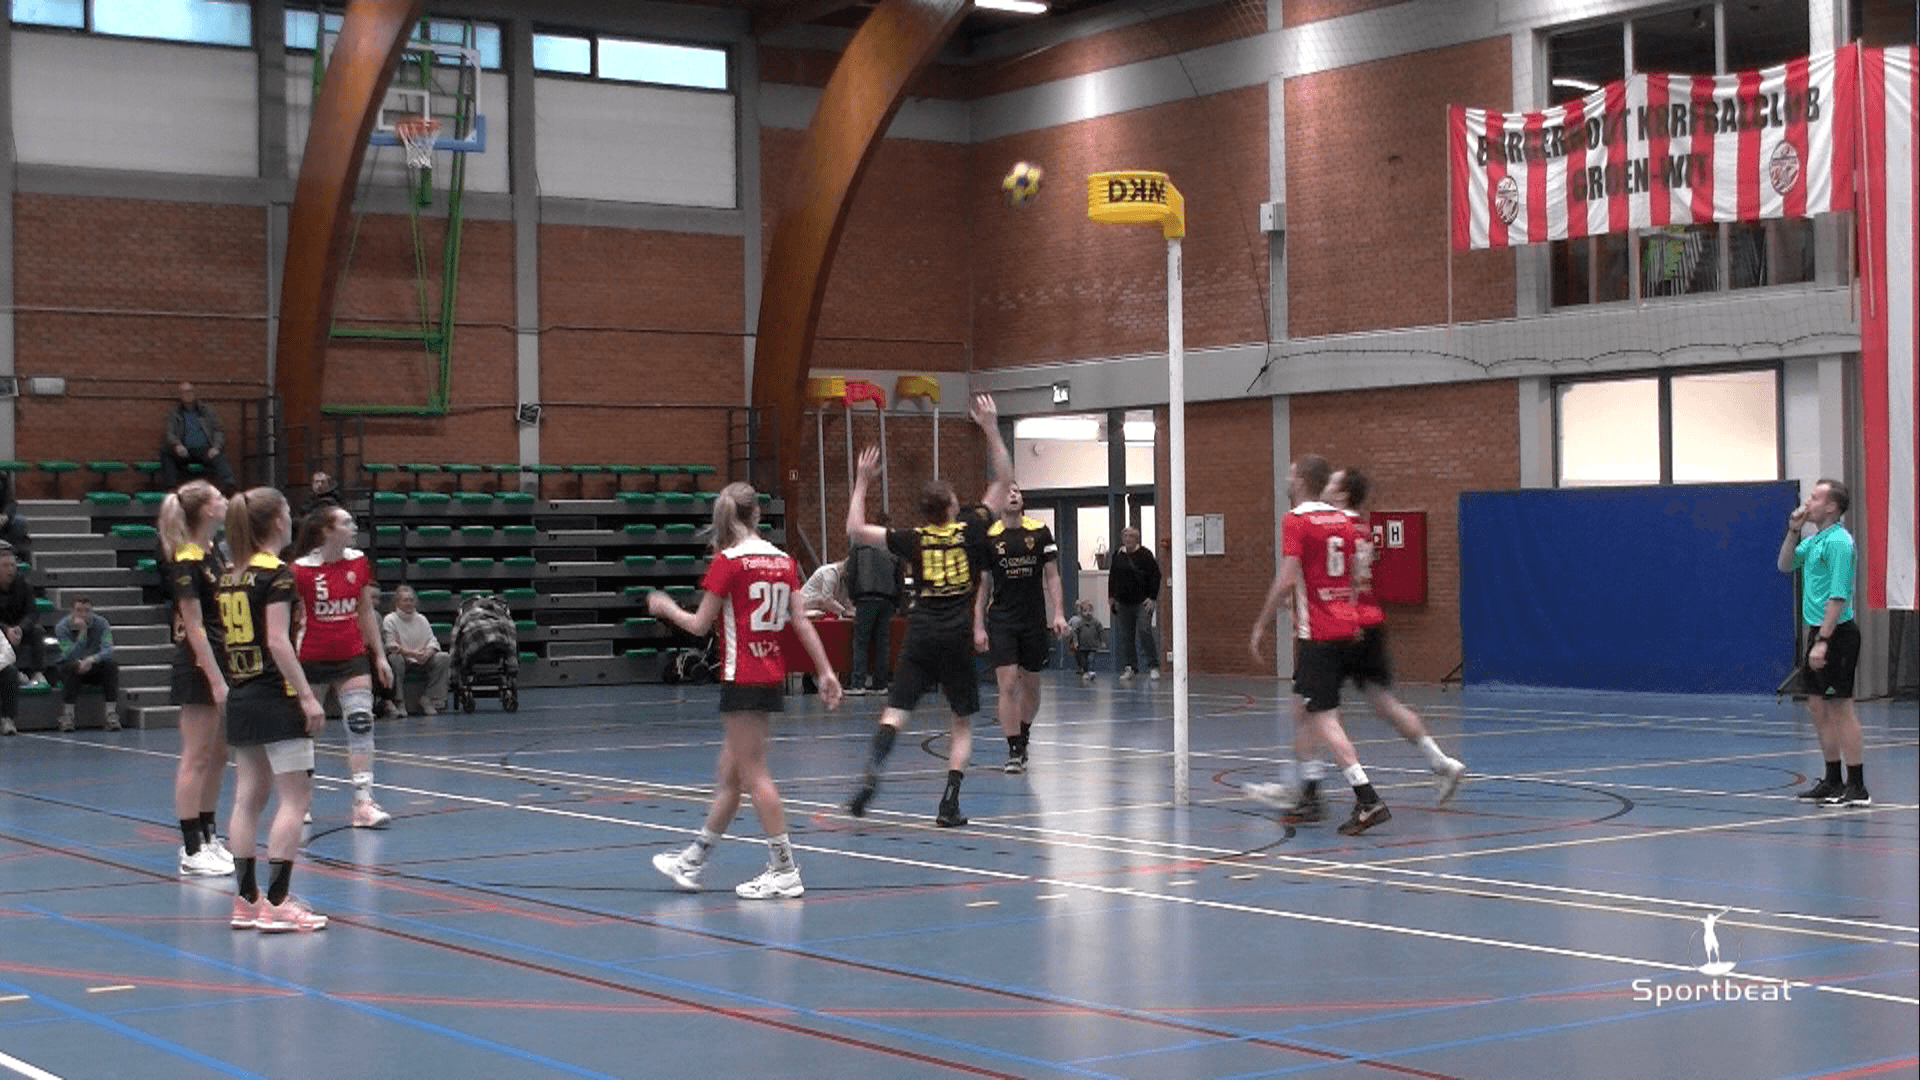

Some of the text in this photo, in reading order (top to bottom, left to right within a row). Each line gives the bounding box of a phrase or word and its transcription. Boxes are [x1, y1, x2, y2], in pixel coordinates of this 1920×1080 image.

[1638, 87, 1820, 140] KORFBALCLUB
[1326, 535, 1345, 577] 6
[1391, 526, 1400, 542] H
[217, 591, 255, 644] 99
[748, 581, 791, 632] 20
